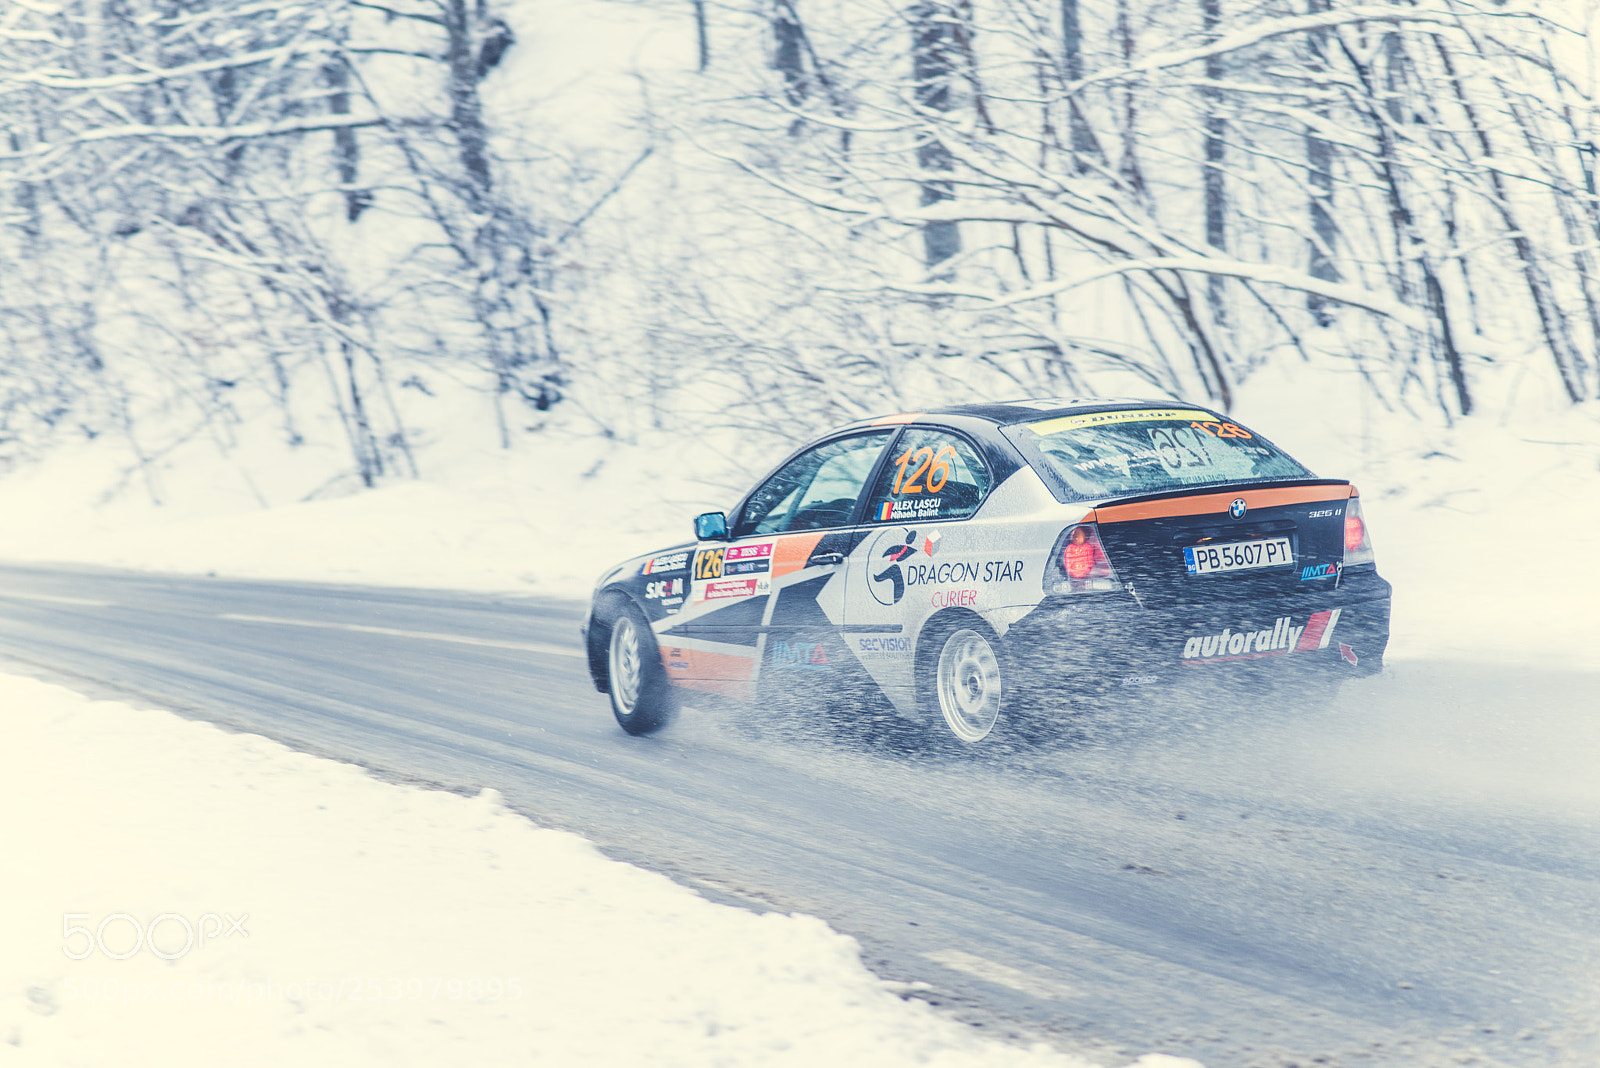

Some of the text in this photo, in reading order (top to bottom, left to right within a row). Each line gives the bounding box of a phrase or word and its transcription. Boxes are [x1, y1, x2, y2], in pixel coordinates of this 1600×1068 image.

[1190, 421, 1252, 439] 126
[893, 446, 956, 494] 126
[890, 507, 939, 519] Mihaela Balint
[892, 498, 941, 511] ALEX LASCU
[696, 548, 724, 579] 126
[1197, 541, 1287, 571] PB 5607 PT
[907, 560, 1024, 586] DRAGON STAR
[1188, 564, 1196, 572] BG
[931, 589, 977, 608] CURIER
[1183, 616, 1304, 660] autorally
